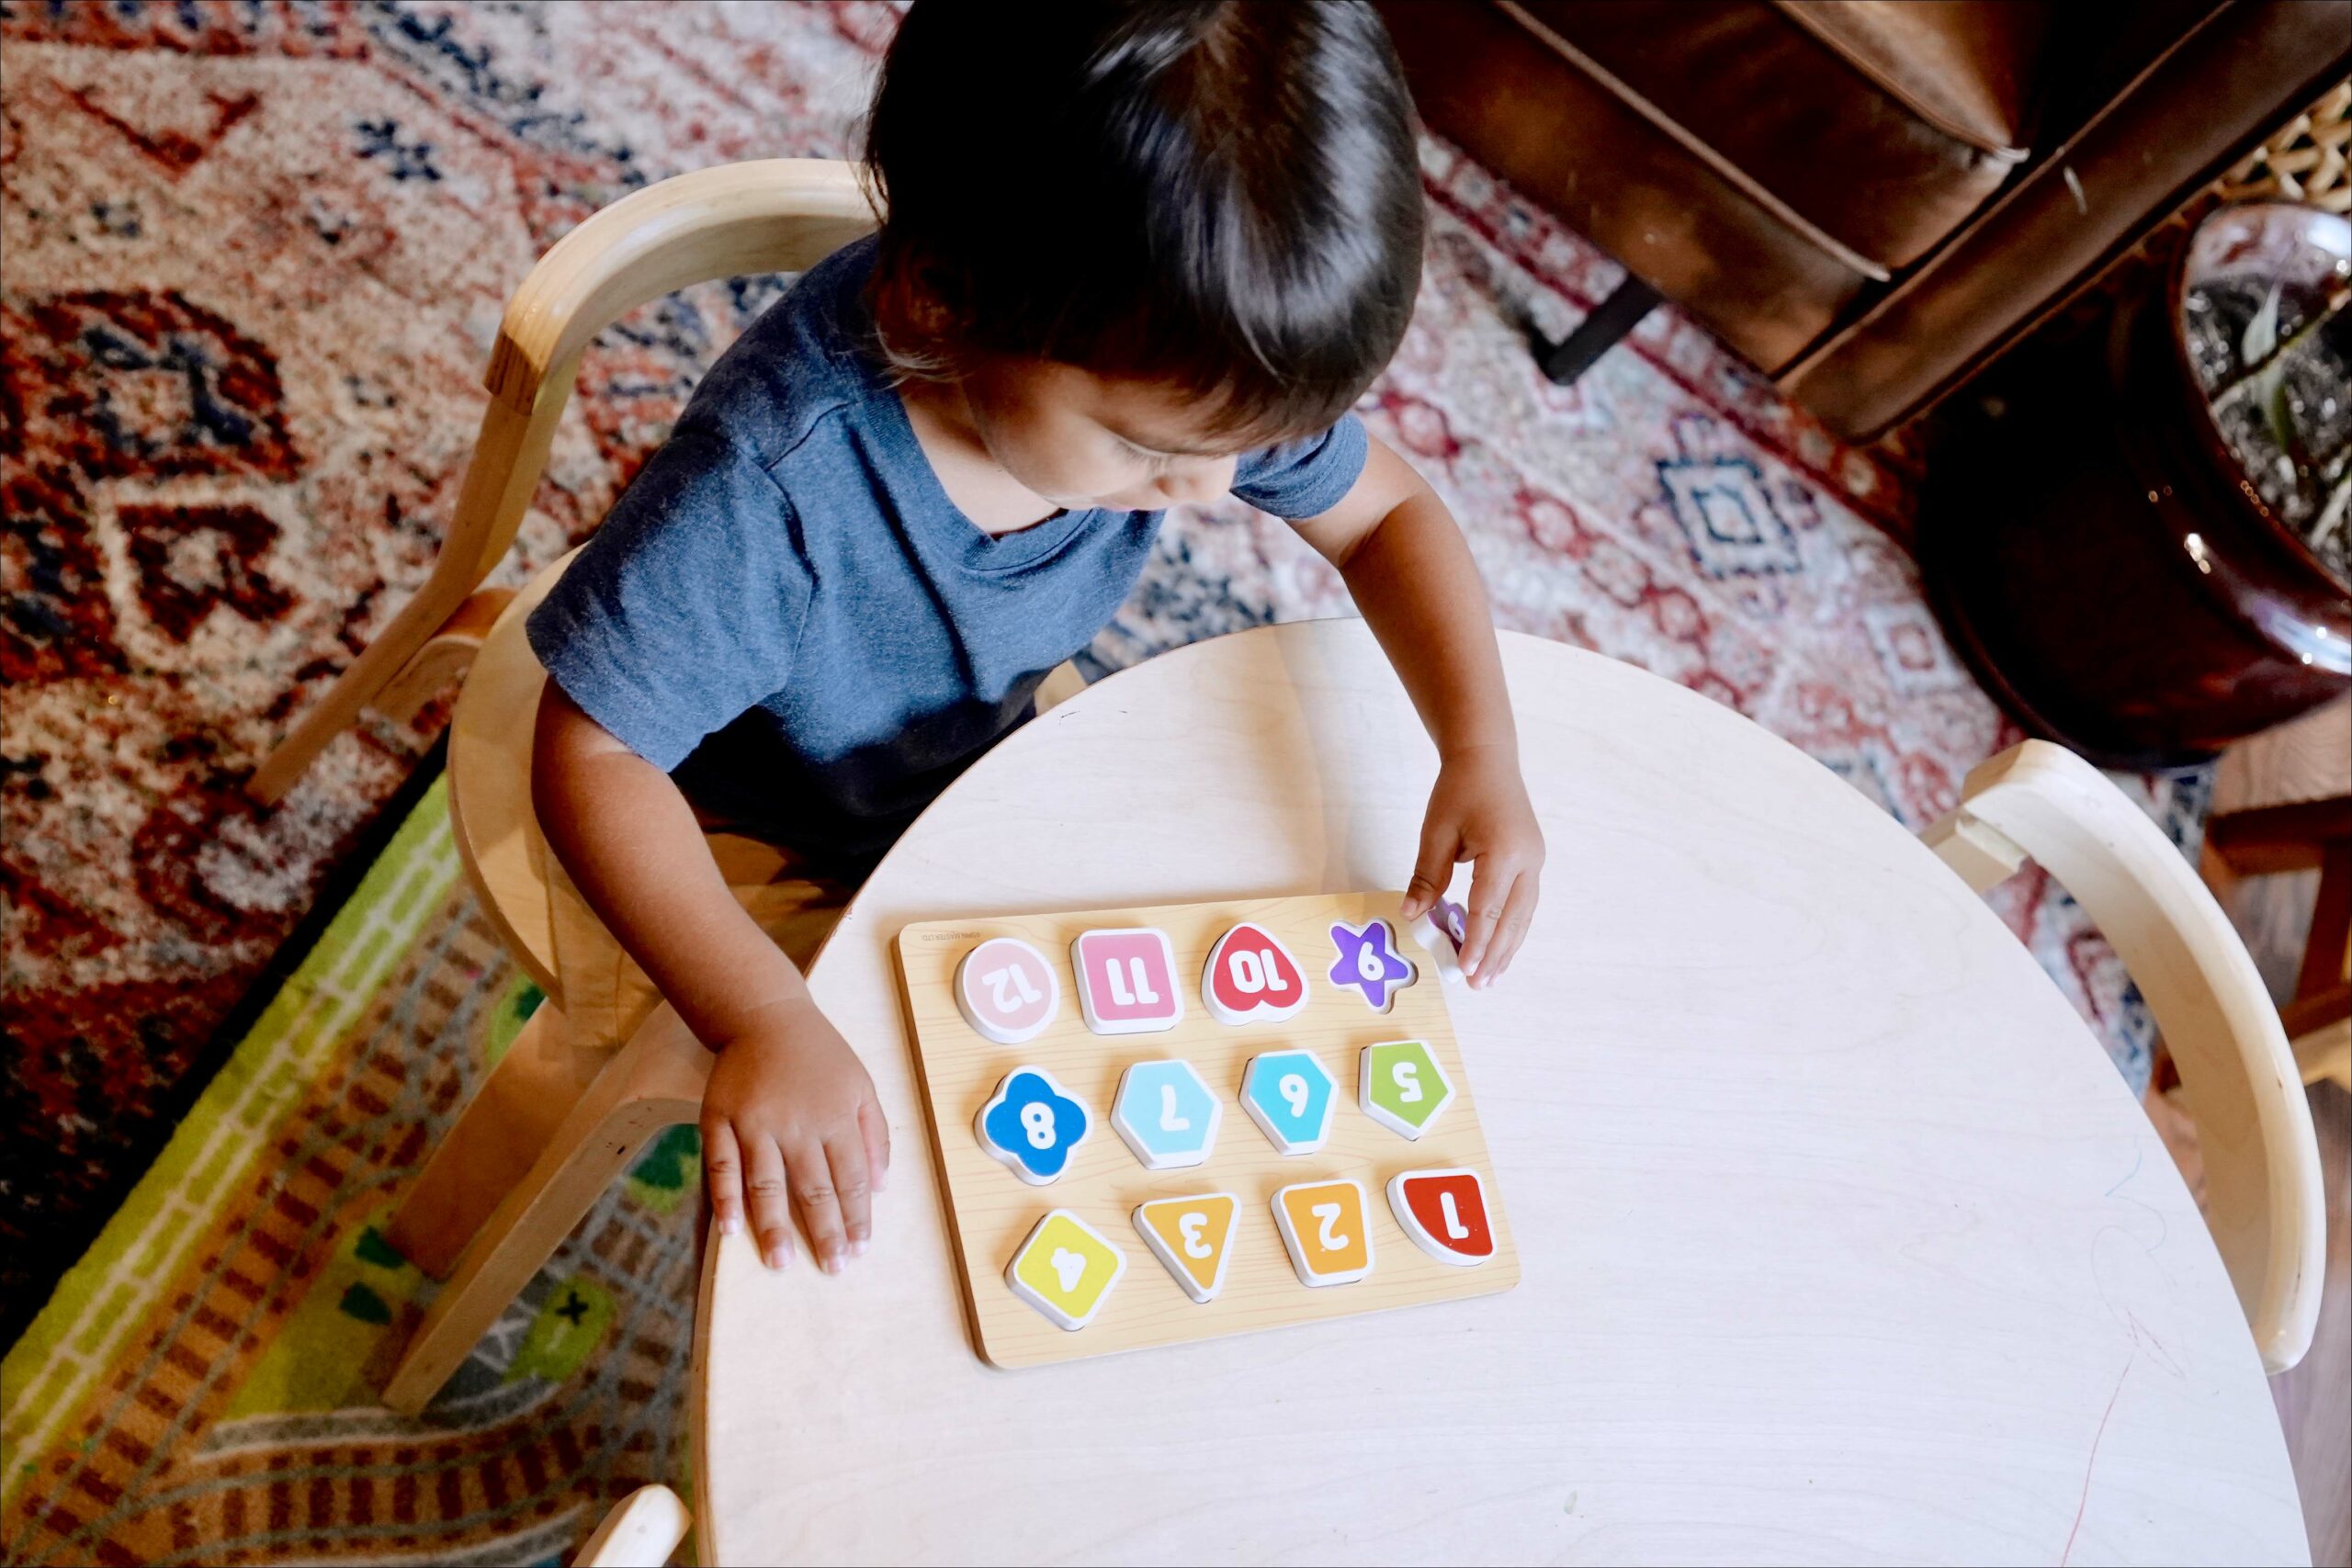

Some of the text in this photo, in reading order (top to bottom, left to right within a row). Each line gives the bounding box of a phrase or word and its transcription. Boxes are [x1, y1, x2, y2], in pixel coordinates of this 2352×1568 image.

[935, 932, 961, 942] MASTER
[1105, 956, 1159, 1006] 11
[1228, 949, 1288, 993] 10
[1358, 942, 1385, 981] 9
[981, 964, 1043, 1013] 12
[1279, 1074, 1308, 1118] 6
[1392, 1062, 1423, 1102] 5
[1020, 1101, 1057, 1149] 8
[1159, 1085, 1190, 1131] 7
[1179, 1213, 1213, 1258] 3
[1311, 1202, 1349, 1250] 2
[1440, 1191, 1469, 1239] 1
[1050, 1247, 1087, 1293] 4
